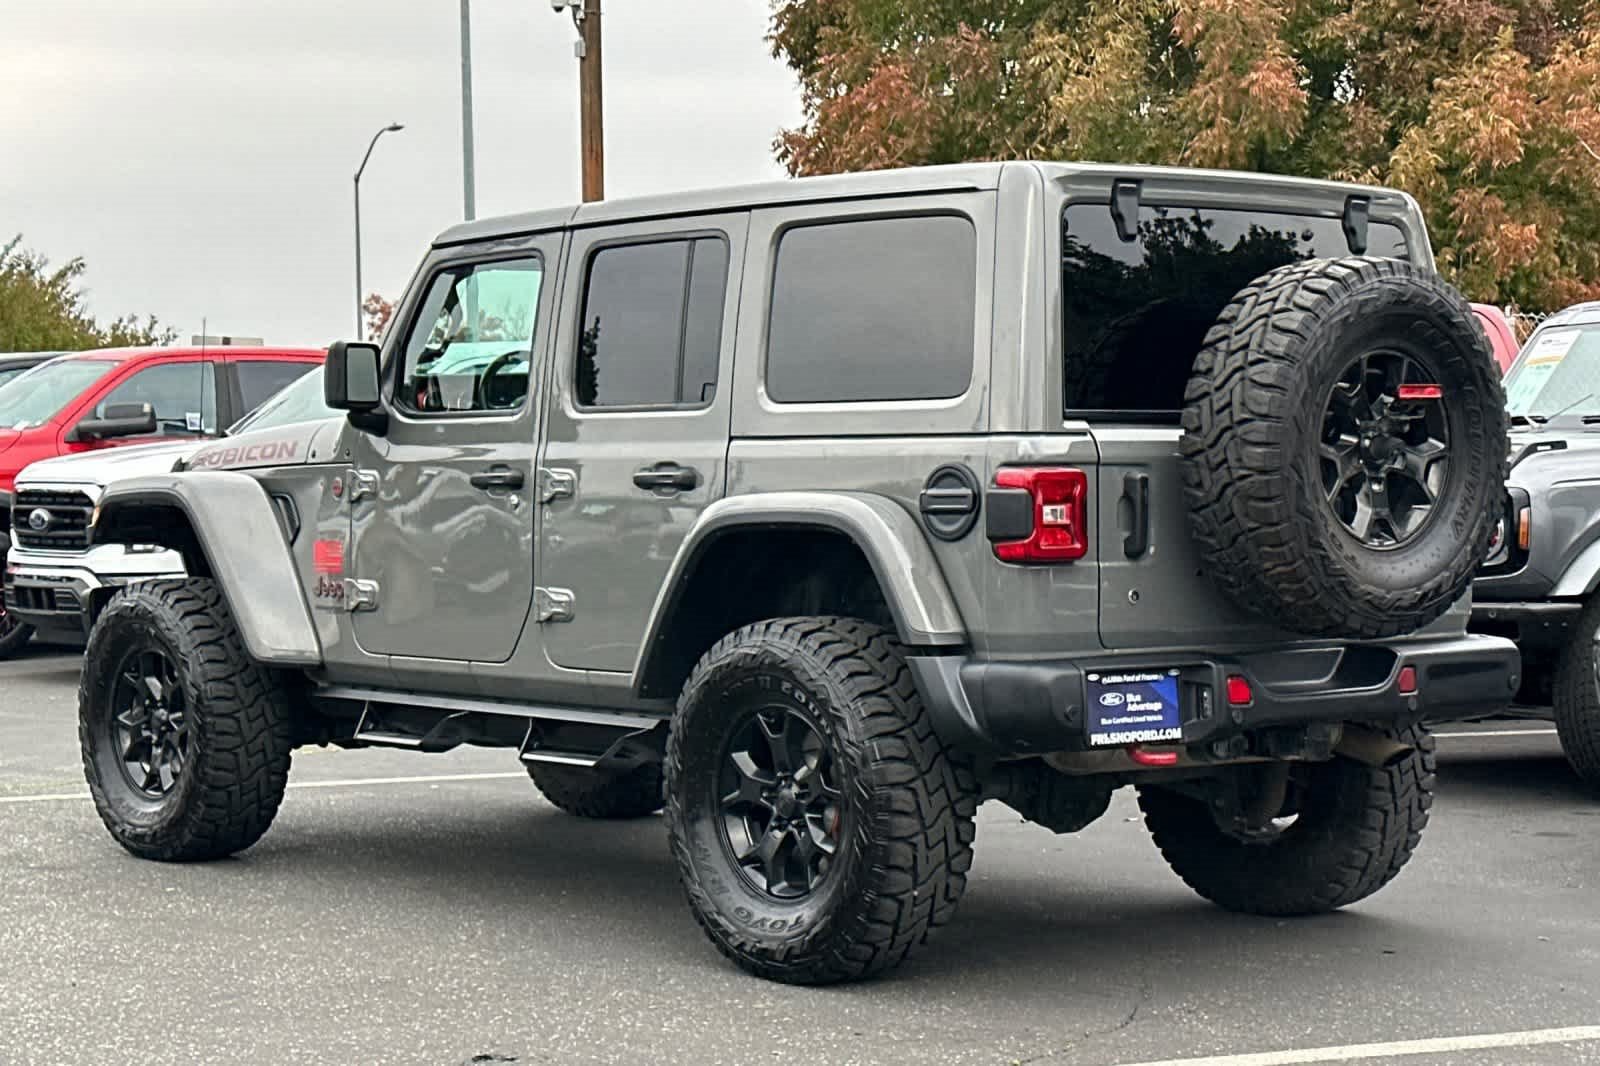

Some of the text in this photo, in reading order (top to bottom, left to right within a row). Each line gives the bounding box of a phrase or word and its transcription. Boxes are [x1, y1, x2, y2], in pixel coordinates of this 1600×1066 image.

[191, 440, 297, 466] RUBICON
[313, 576, 344, 601] Jeep
[1126, 702, 1162, 711] Advantage
[734, 906, 805, 934] TOYO
